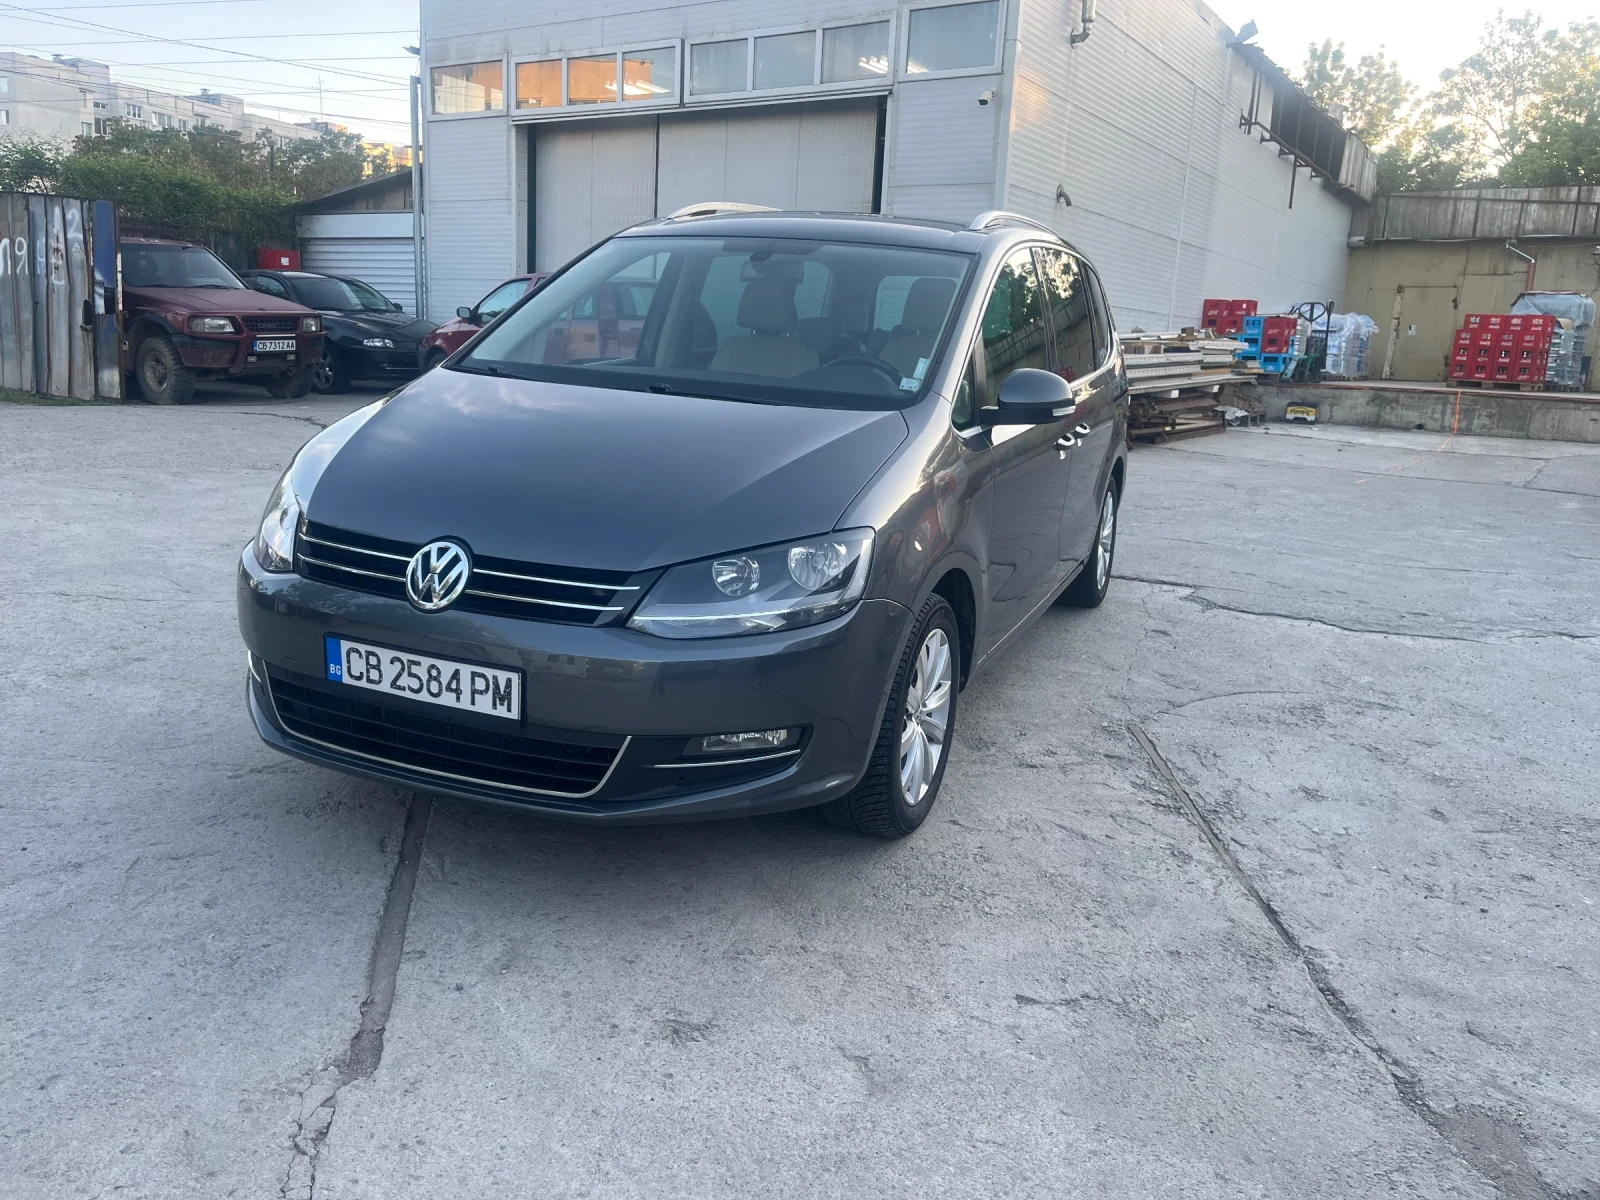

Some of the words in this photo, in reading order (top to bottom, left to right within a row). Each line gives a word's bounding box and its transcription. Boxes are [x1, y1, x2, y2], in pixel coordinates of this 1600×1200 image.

[257, 341, 267, 350] CB
[268, 341, 285, 350] 7312
[286, 341, 295, 350] AA
[329, 663, 342, 675] BG
[346, 647, 384, 685] CB
[389, 656, 463, 703] 2584
[470, 670, 513, 713] PM
